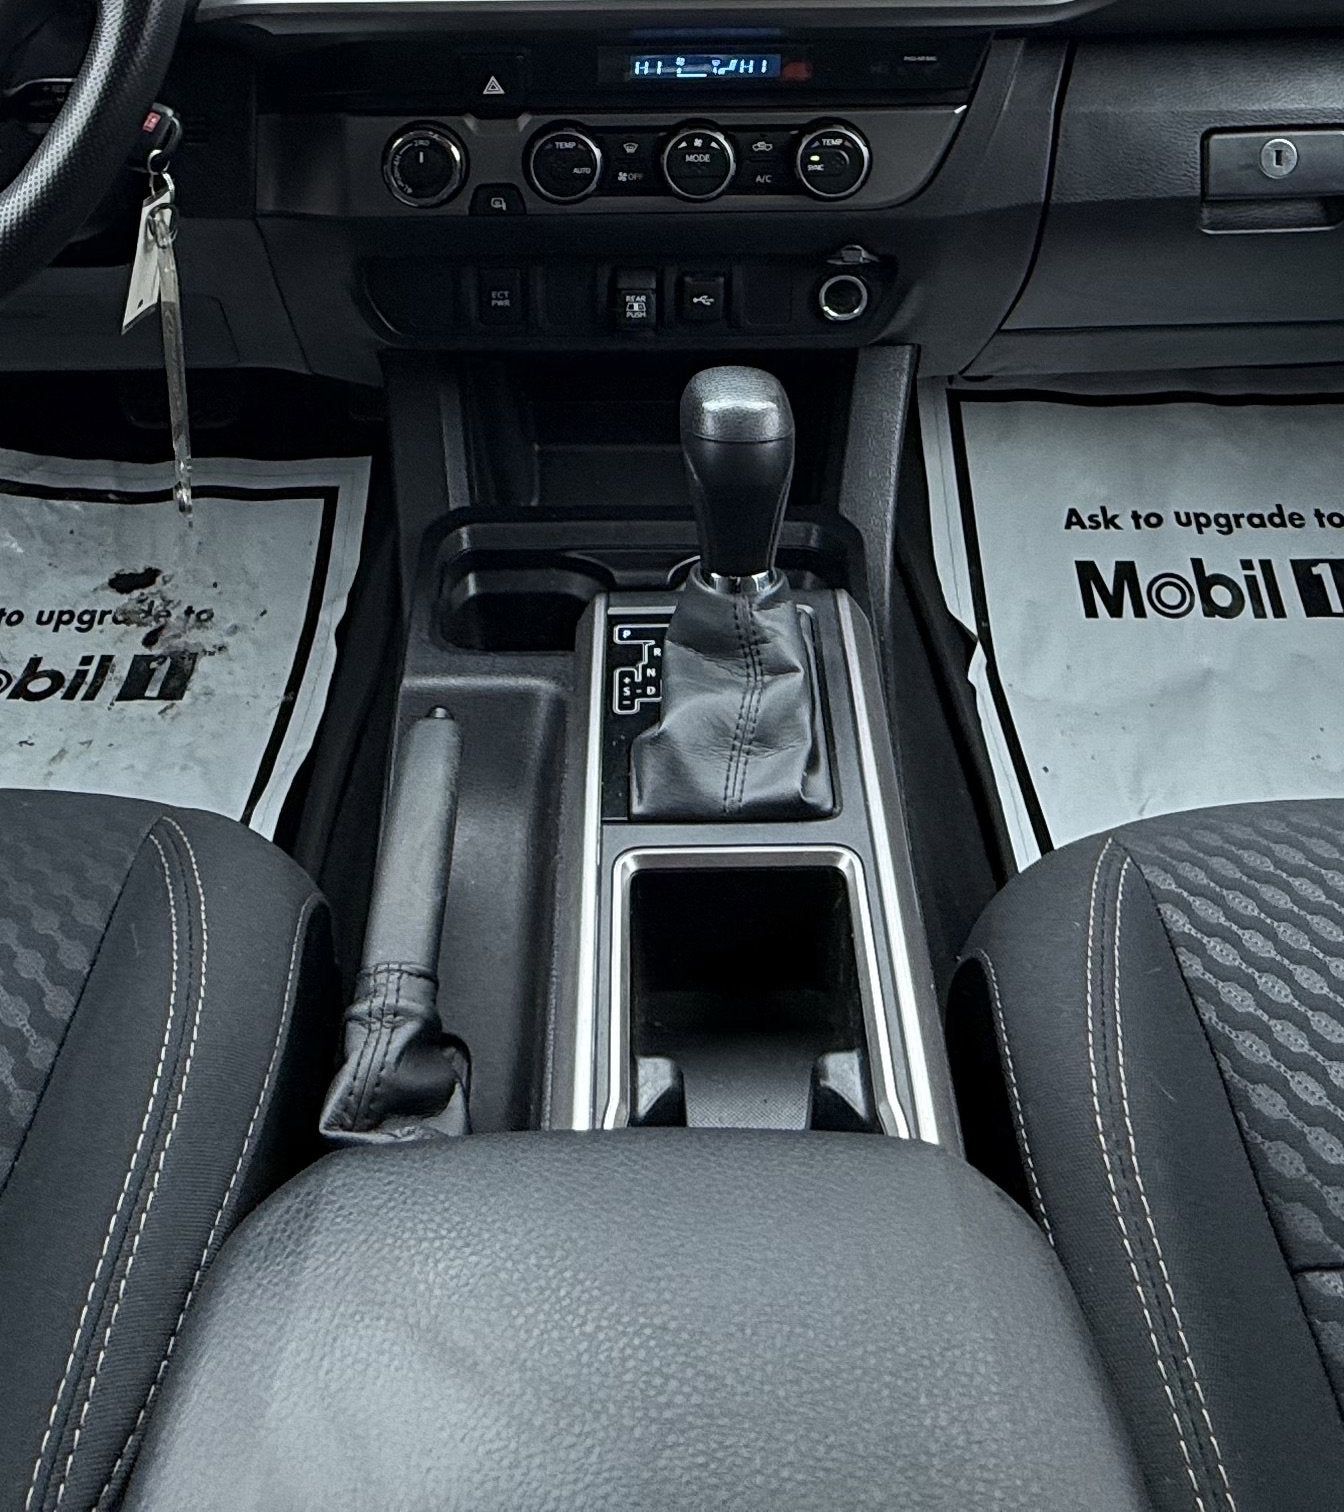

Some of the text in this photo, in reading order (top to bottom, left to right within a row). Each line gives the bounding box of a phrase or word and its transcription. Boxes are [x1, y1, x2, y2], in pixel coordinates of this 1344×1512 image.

[555, 141, 576, 149] TEMP
[822, 138, 843, 146] TEMP
[685, 154, 710, 163] MODE
[628, 173, 644, 181] OFF
[756, 173, 772, 183] A/C
[491, 299, 510, 307] PWR
[626, 295, 646, 303] REAR
[626, 311, 646, 319] PUSH
[1064, 506, 1124, 530] Ask
[1131, 510, 1163, 530] to
[1174, 504, 1306, 536] upgrade
[1074, 557, 1288, 619] Mobil
[184, 605, 215, 623] to
[622, 629, 632, 639] P
[653, 647, 662, 657] R
[646, 668, 656, 678] N
[623, 686, 656, 696] S D
